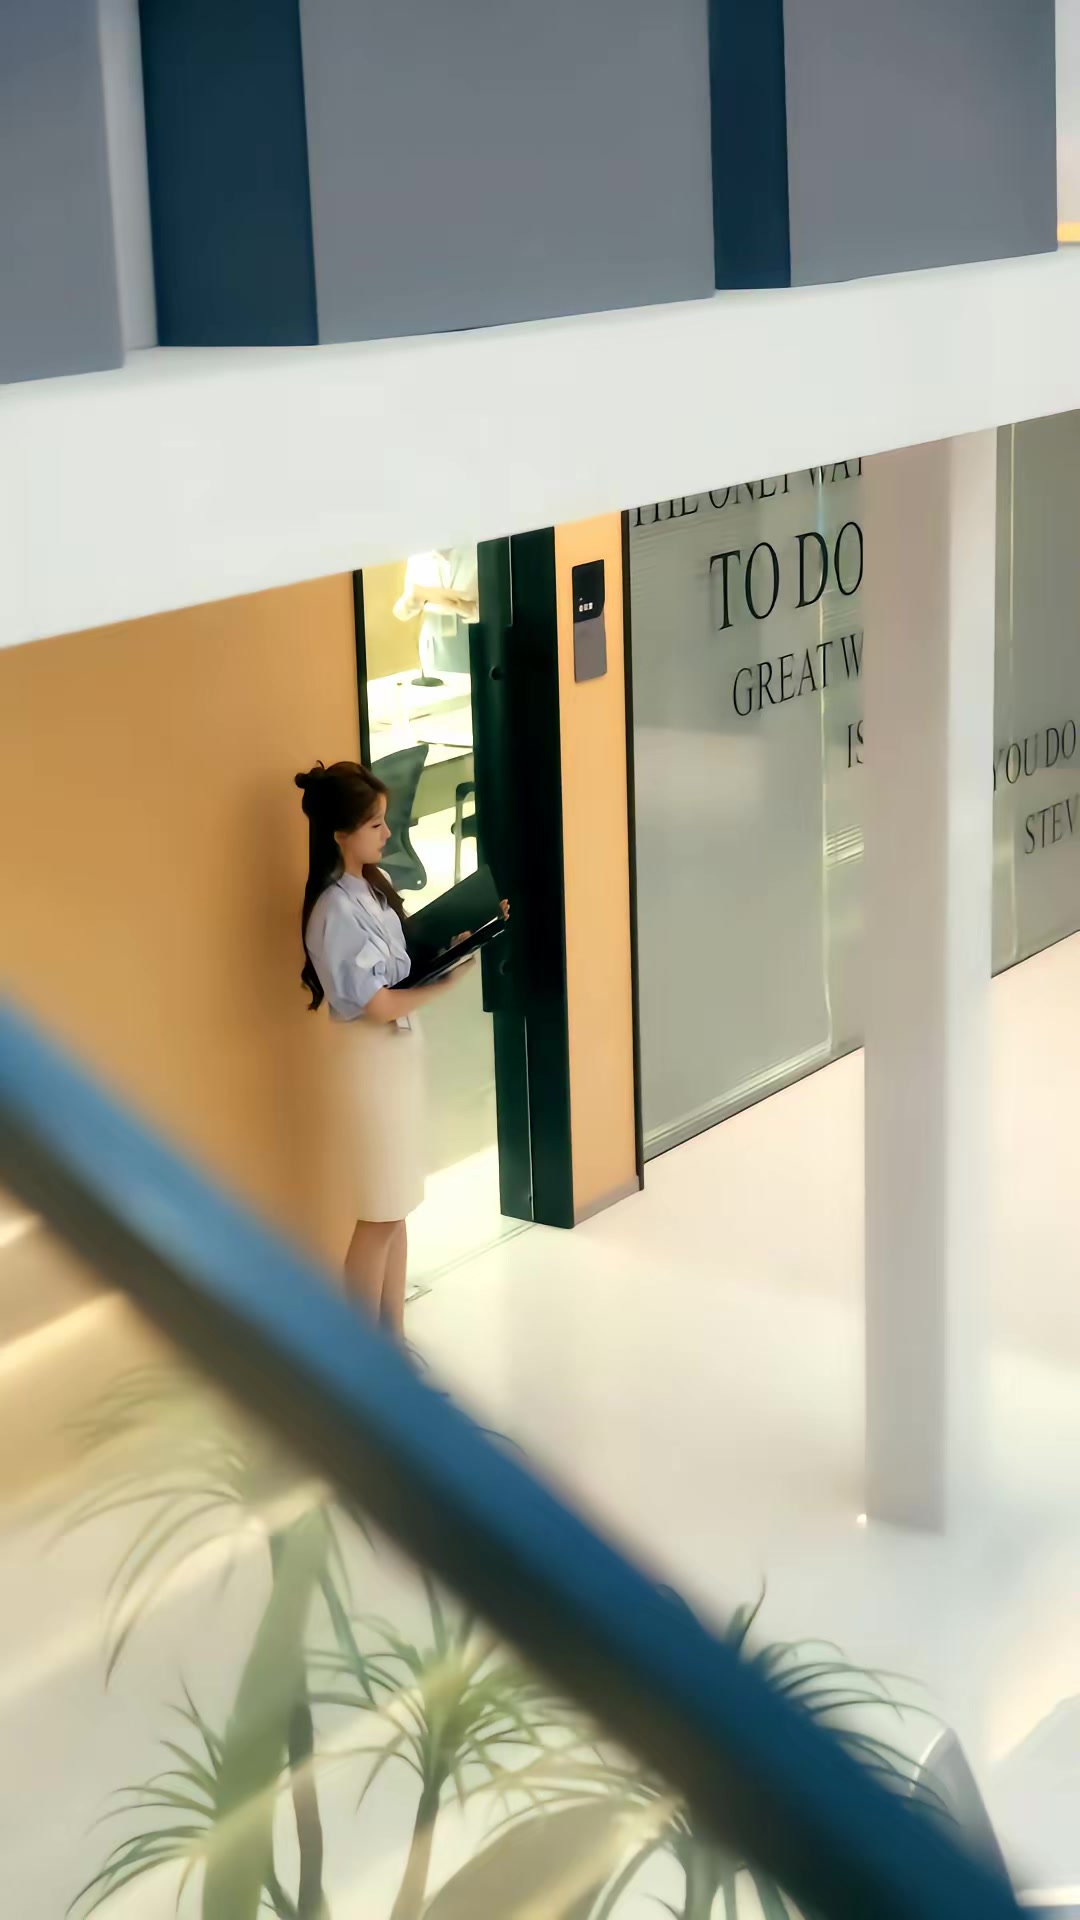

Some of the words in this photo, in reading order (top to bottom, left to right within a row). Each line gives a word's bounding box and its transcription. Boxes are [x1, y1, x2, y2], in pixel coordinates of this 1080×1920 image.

[709, 542, 779, 630] TO
[795, 521, 863, 608] DO
[733, 641, 833, 716] GREAT
[1046, 719, 1076, 768] DO
